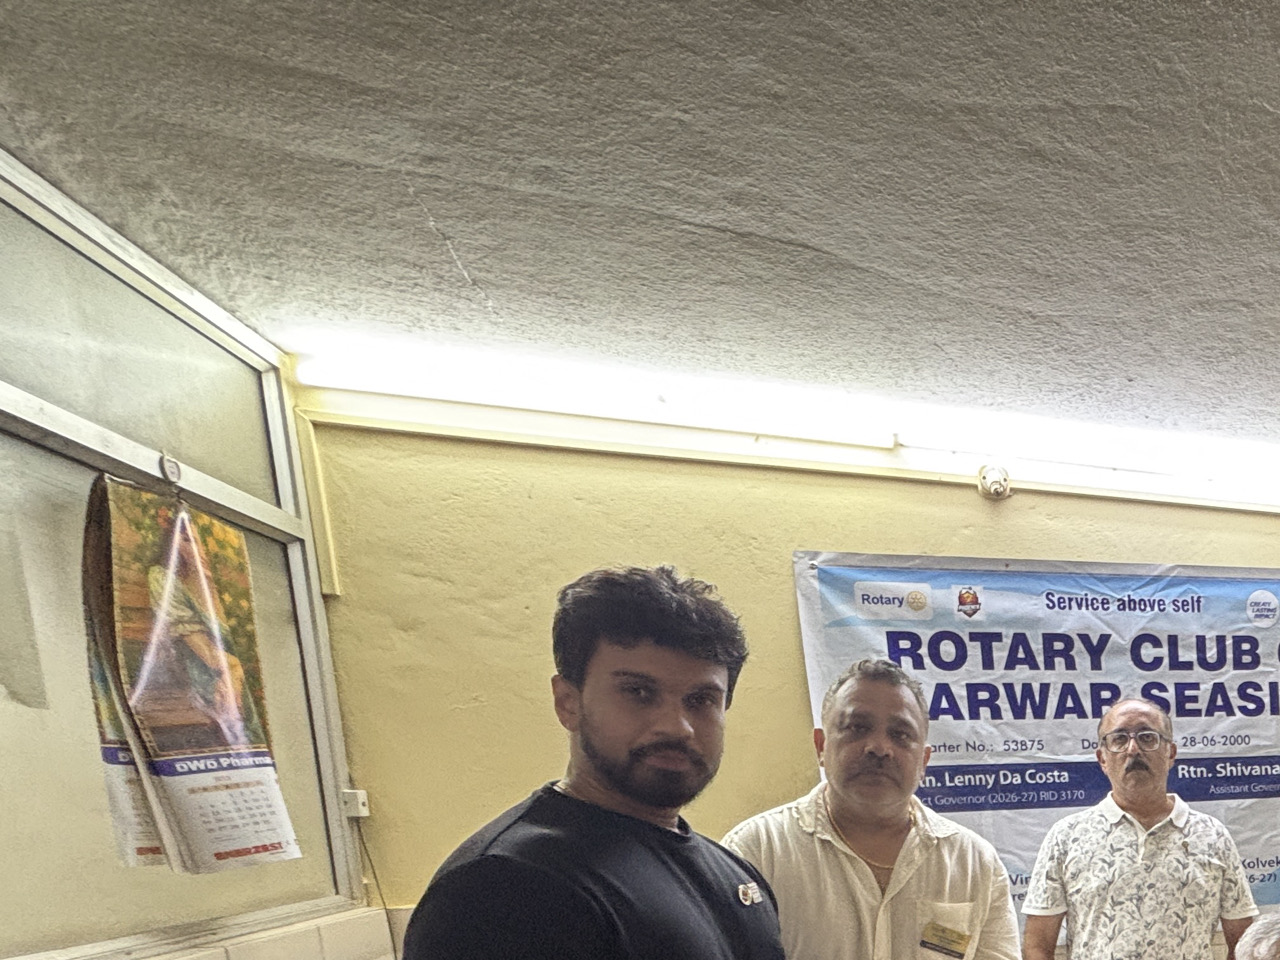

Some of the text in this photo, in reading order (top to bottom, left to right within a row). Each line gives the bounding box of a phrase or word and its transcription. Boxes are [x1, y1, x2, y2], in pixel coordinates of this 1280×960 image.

[861, 593, 905, 608] Rotary
[1045, 591, 1203, 614] Service above self
[886, 630, 1112, 671] ROTARY
[1130, 633, 1261, 672] CLUB
[928, 682, 1122, 721] ARWAR
[930, 741, 962, 753] arter
[1003, 739, 1045, 752] 53875
[1181, 734, 1251, 747] 28-06-2000
[221, 755, 274, 769] Pharma
[919, 768, 1070, 789] tn. Lenny Da Costa
[1177, 764, 1212, 779] Rtn.
[1209, 782, 1249, 794] Assistant
[934, 793, 986, 806] Governor
[988, 791, 1038, 804] (2026-27)
[1039, 790, 1058, 801] RID
[1060, 789, 1085, 800] 3170
